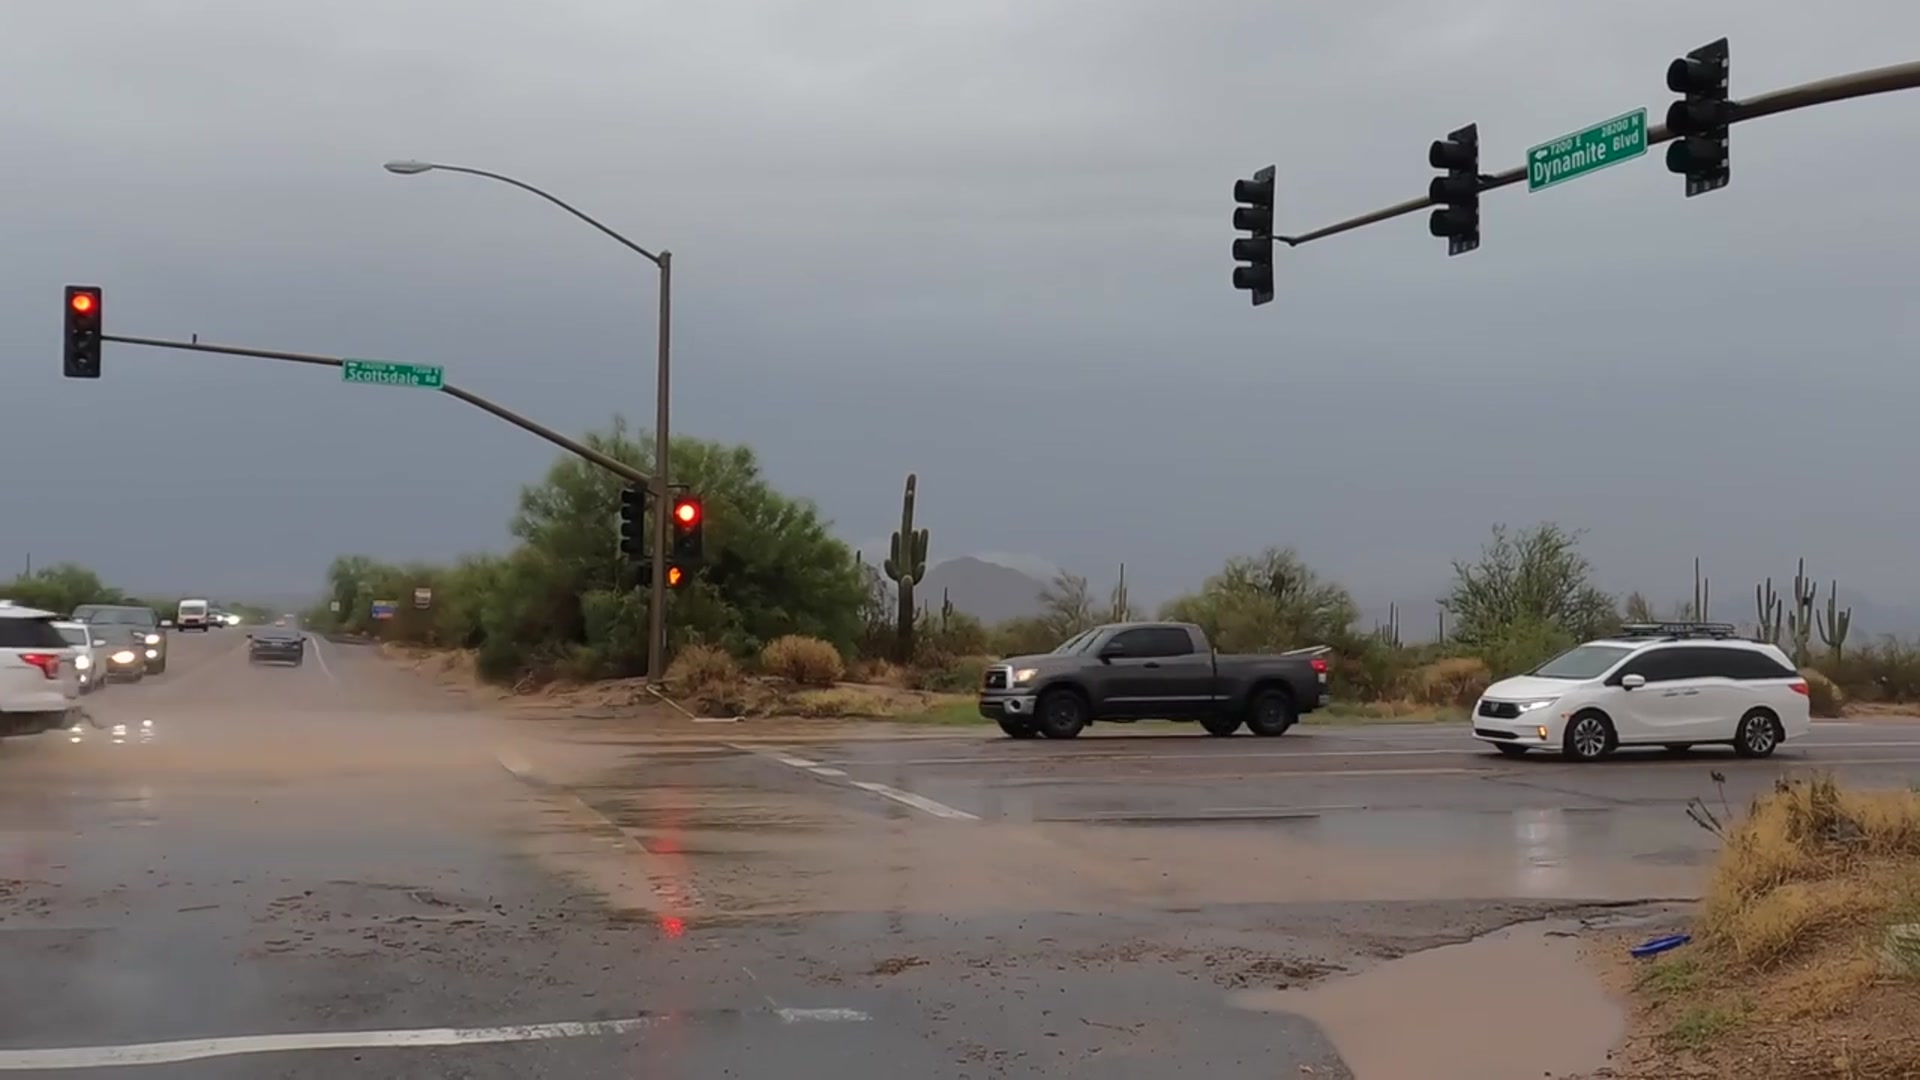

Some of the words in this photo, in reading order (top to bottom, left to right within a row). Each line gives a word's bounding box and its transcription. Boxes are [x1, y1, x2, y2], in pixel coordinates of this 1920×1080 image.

[1631, 115, 1639, 127] N
[1575, 135, 1582, 147] E
[1533, 142, 1606, 183] Dynamite
[1612, 128, 1639, 151] Blvd
[348, 368, 419, 385] Scottsdale
